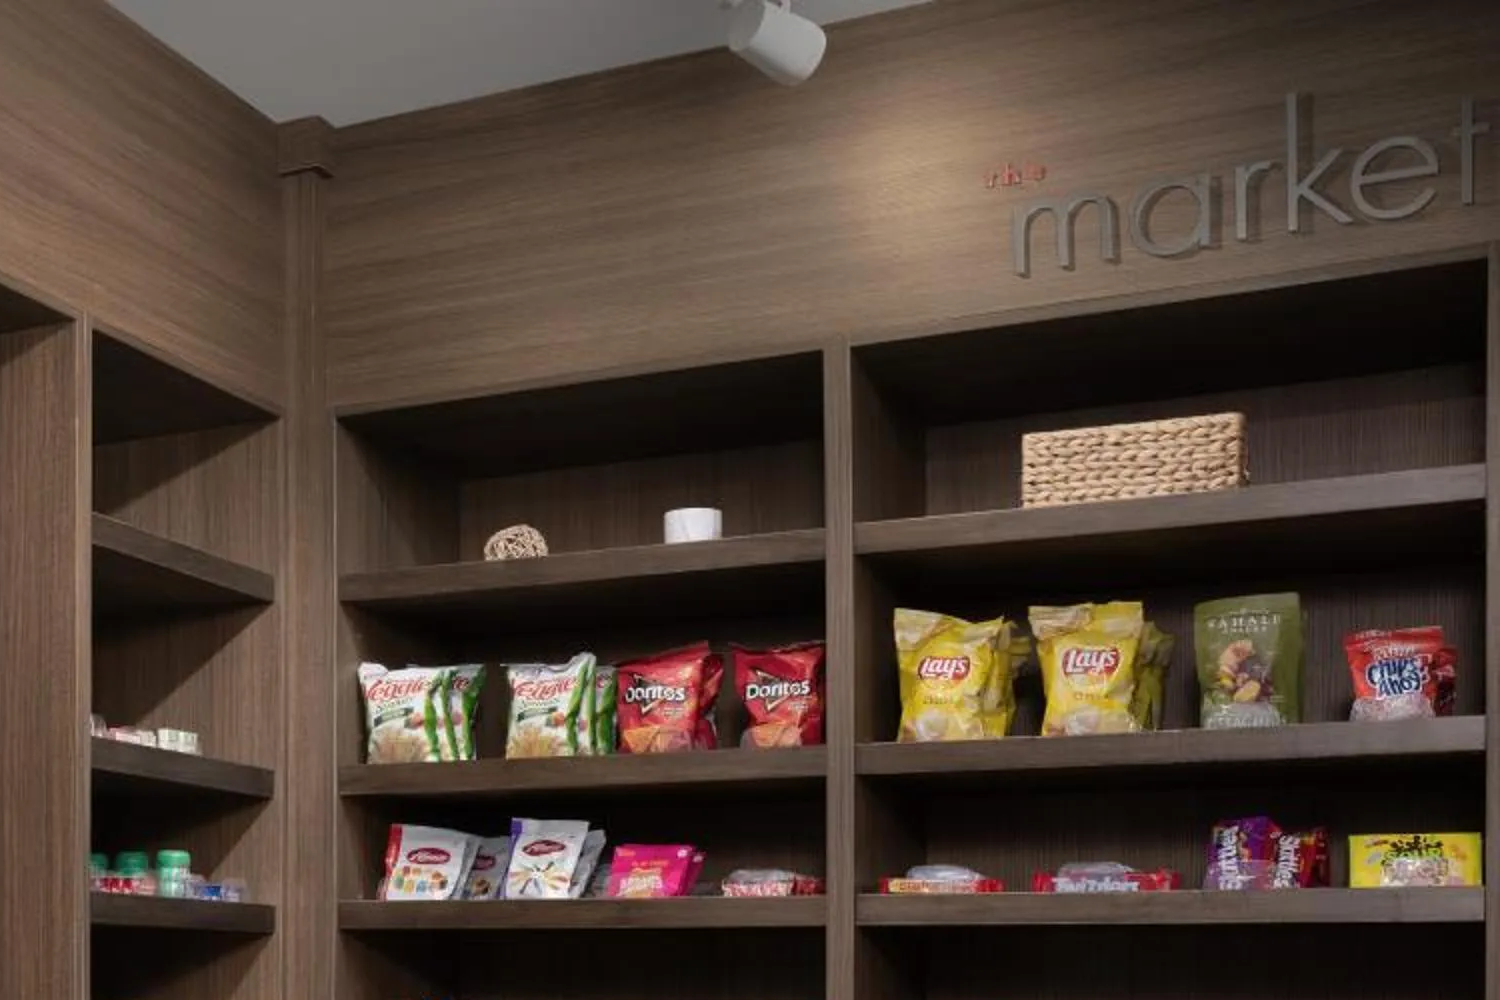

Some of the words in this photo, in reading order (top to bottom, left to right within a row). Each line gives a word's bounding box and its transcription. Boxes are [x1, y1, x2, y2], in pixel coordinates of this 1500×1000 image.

[1011, 92, 1492, 279] market
[625, 685, 686, 703] Doritos
[745, 680, 811, 700] Doritos
